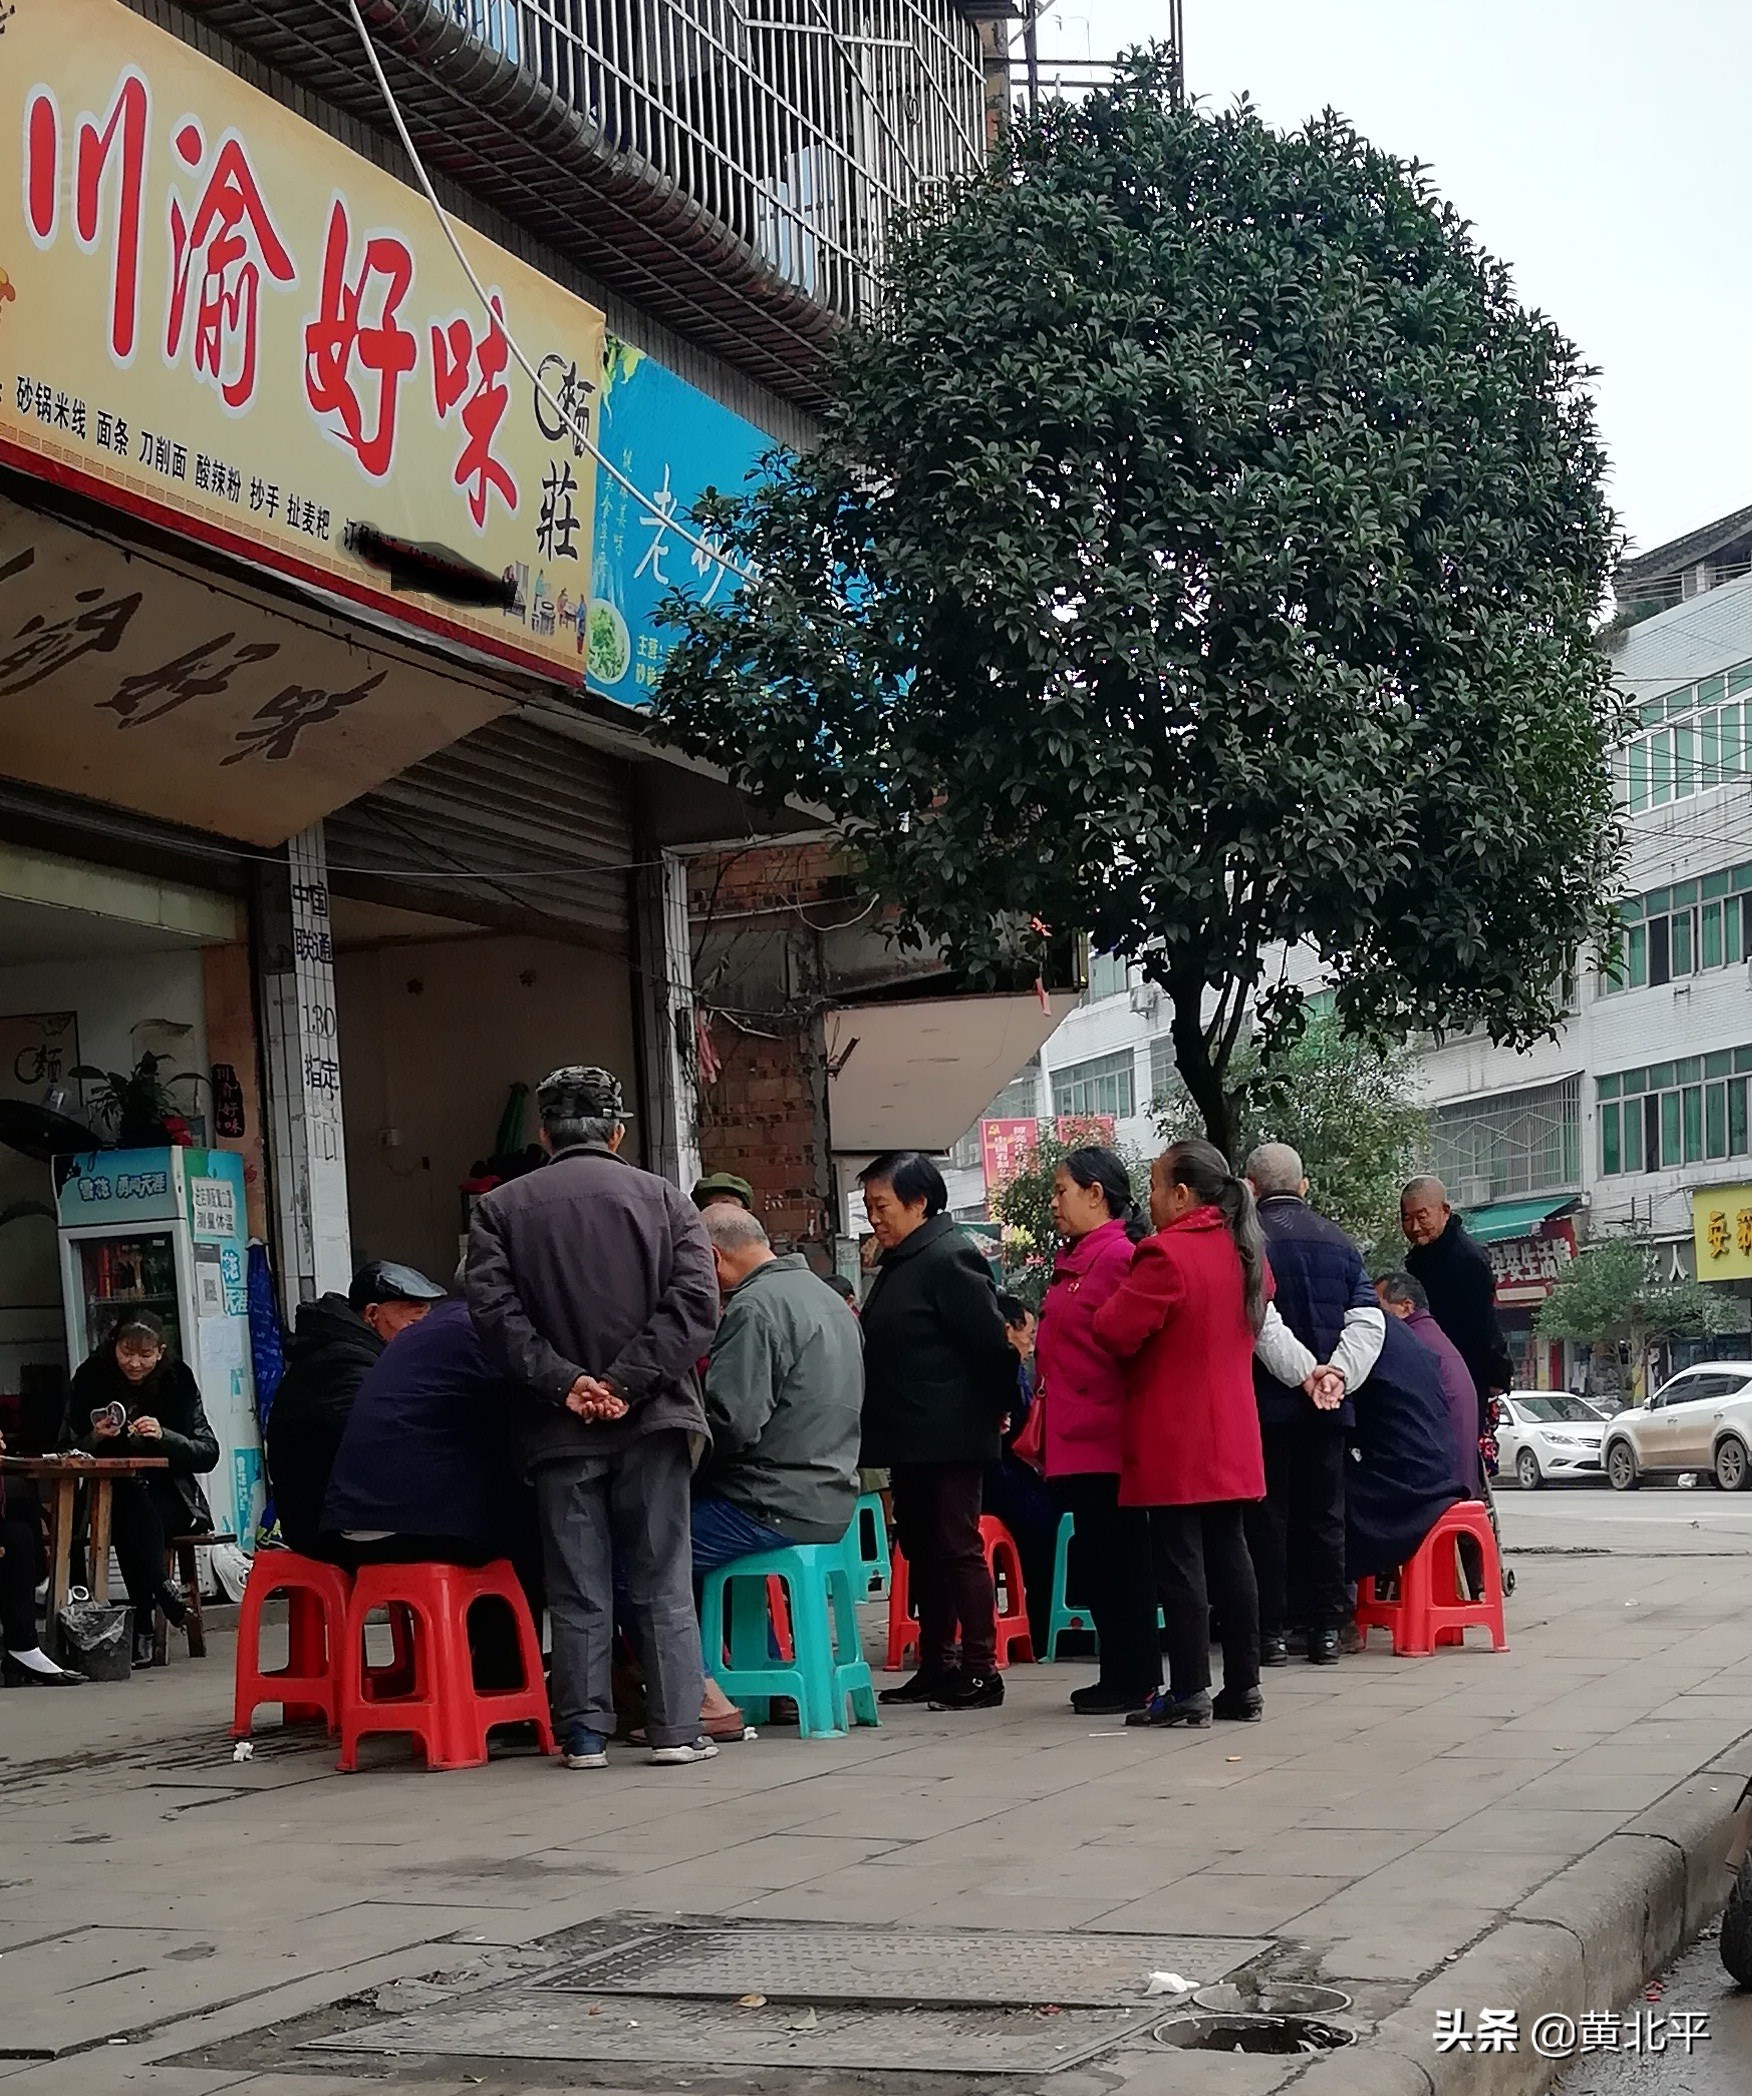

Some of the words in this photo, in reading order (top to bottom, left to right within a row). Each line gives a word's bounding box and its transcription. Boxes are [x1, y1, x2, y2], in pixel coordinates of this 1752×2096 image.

[28, 73, 519, 530] 川渝好味
[16, 375, 87, 440] 砂锅米线
[96, 410, 129, 456] 面条
[138, 430, 188, 481] 刀削面
[195, 453, 242, 503] 酸辣粉
[250, 475, 280, 519] 抄手
[286, 493, 331, 541] 扯麦粑
[291, 879, 329, 918] 中国
[294, 928, 334, 965] 联通
[301, 1004, 336, 1038] 130
